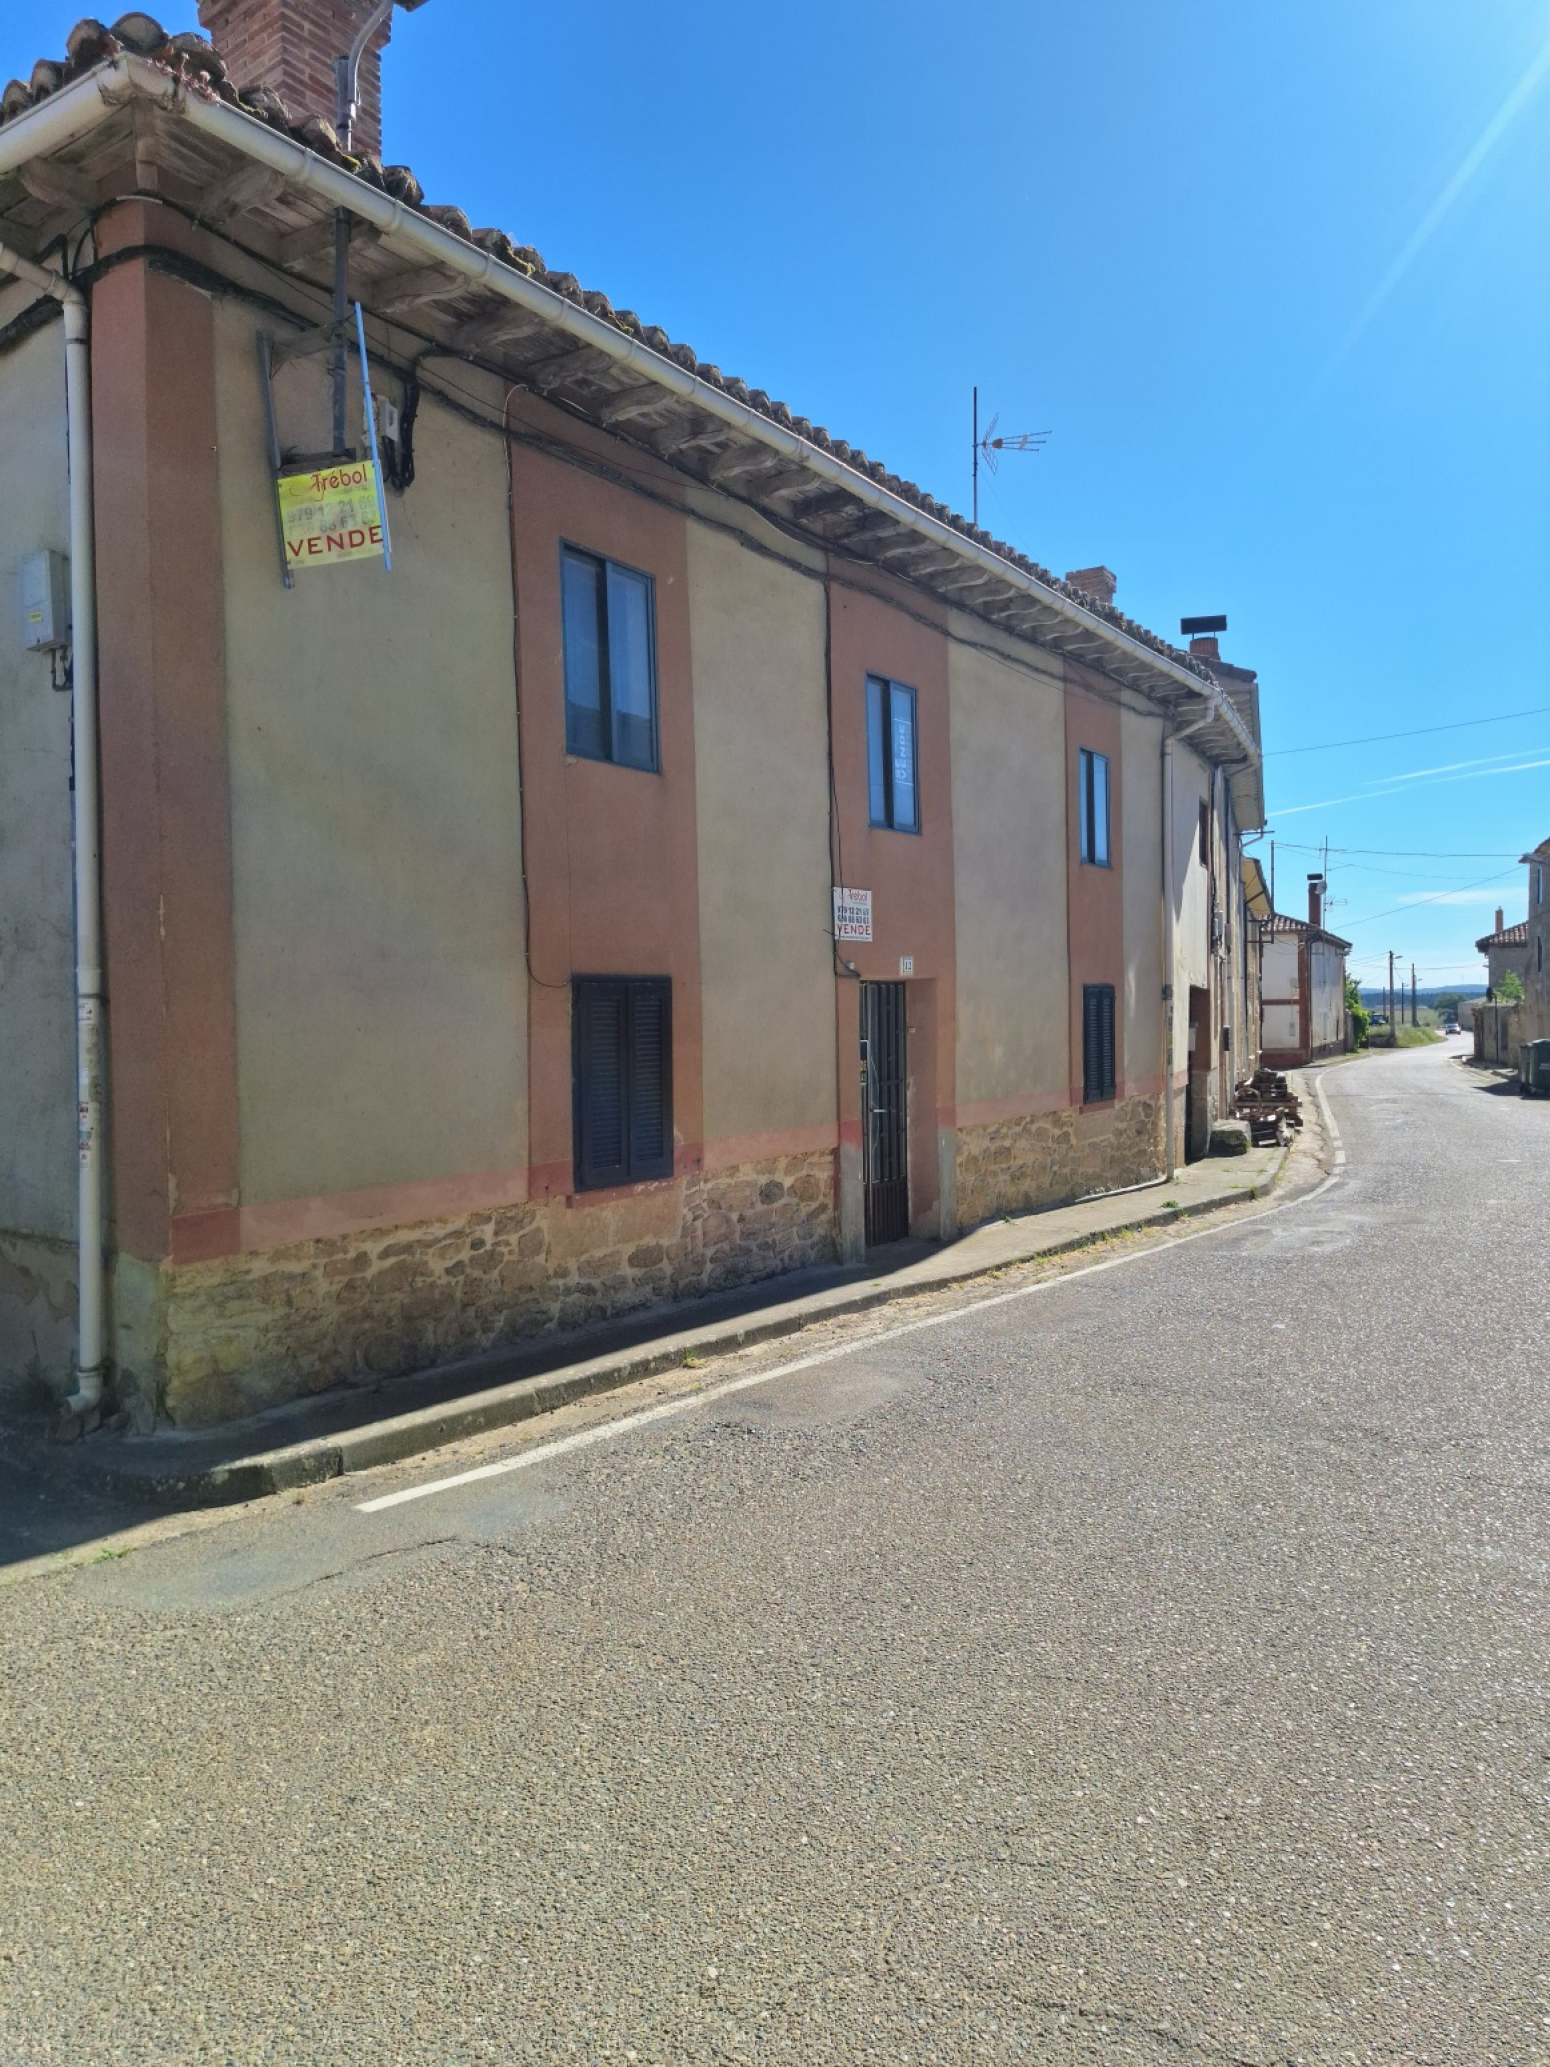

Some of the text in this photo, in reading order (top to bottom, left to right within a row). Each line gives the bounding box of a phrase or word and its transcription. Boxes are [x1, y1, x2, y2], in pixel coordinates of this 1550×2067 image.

[310, 464, 367, 492] Trébol
[287, 525, 384, 557] VENDE
[837, 923, 871, 935] VENDE
